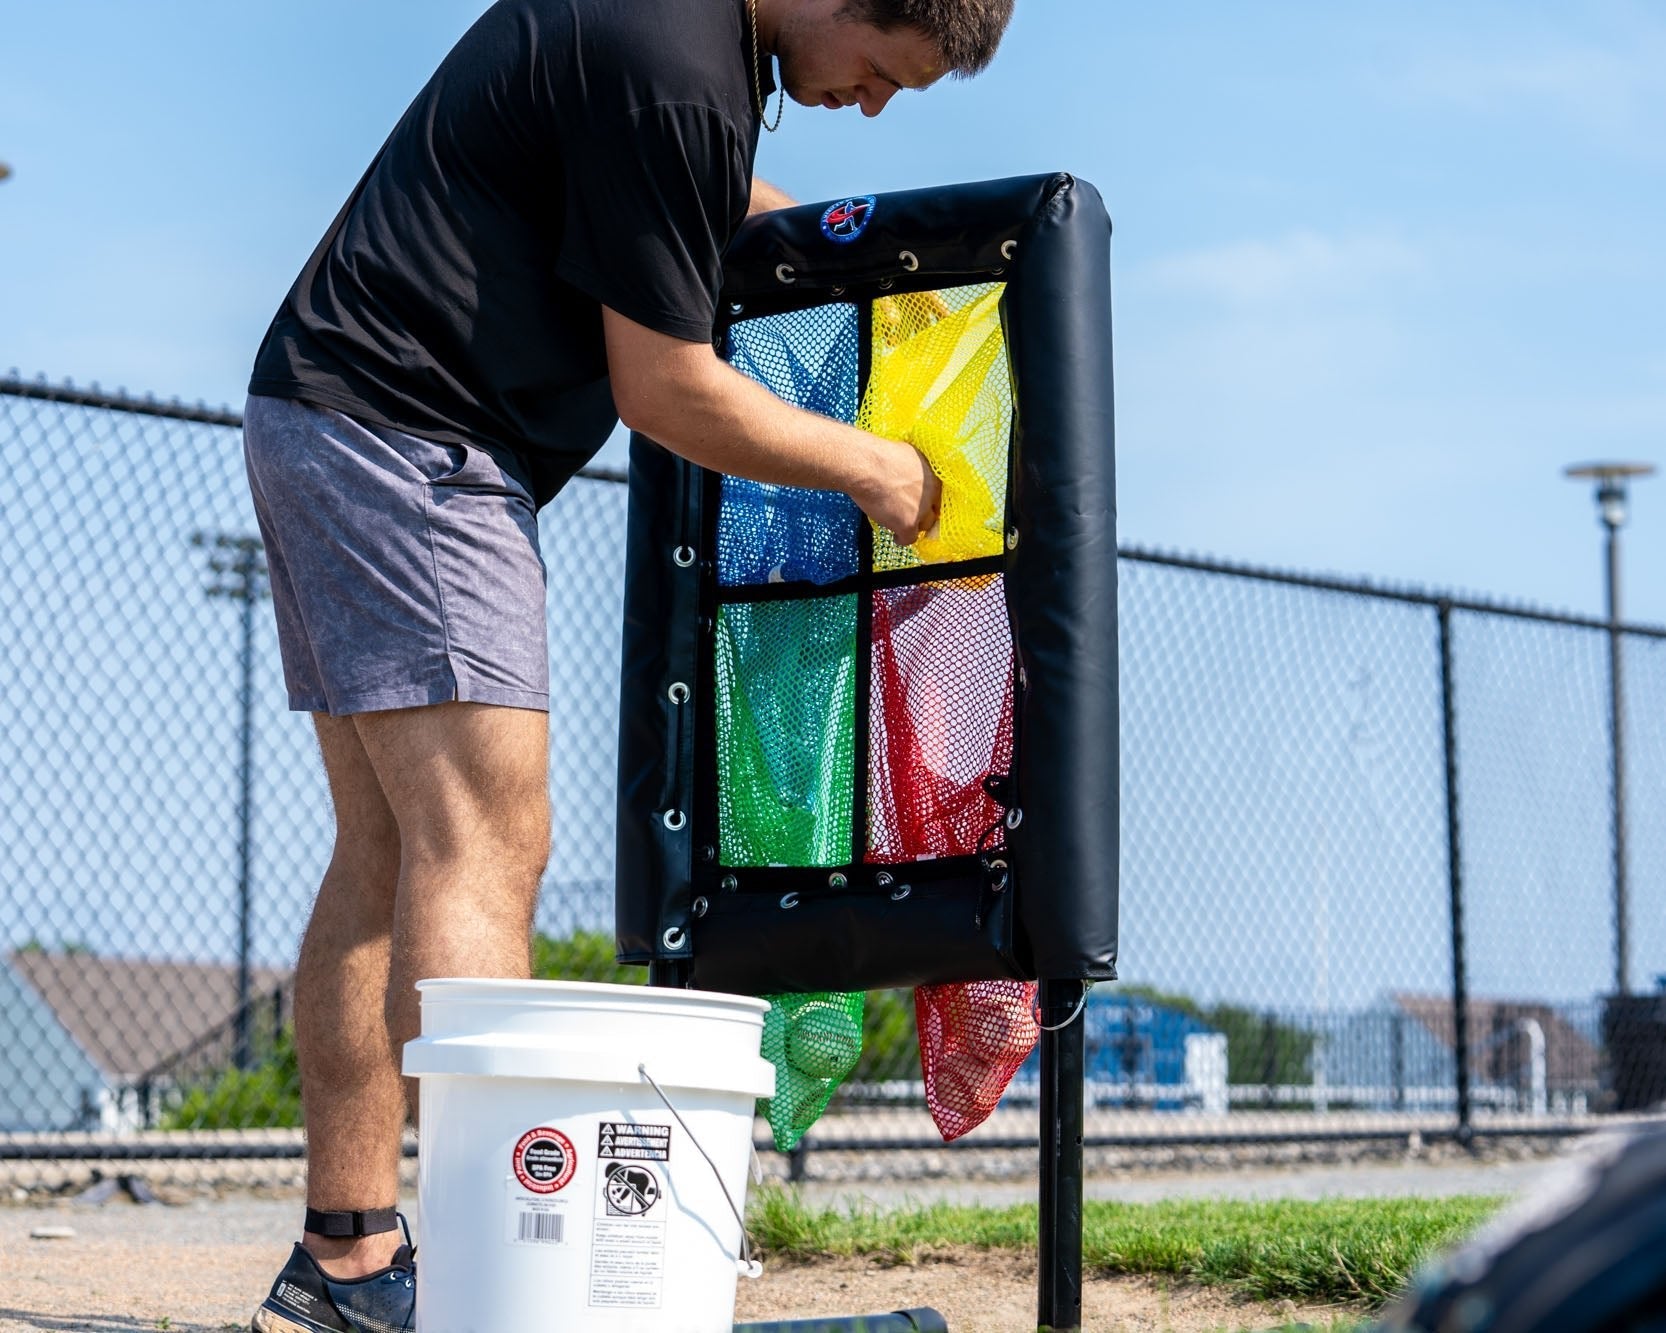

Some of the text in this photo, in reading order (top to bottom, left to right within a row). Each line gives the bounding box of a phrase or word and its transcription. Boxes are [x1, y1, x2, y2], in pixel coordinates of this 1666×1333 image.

[615, 1124, 669, 1137] WARNING
[536, 1130, 565, 1145] Beverage
[614, 1135, 668, 1149] AVERTISSEMENT
[614, 1147, 667, 1160] ADVERTENCIA
